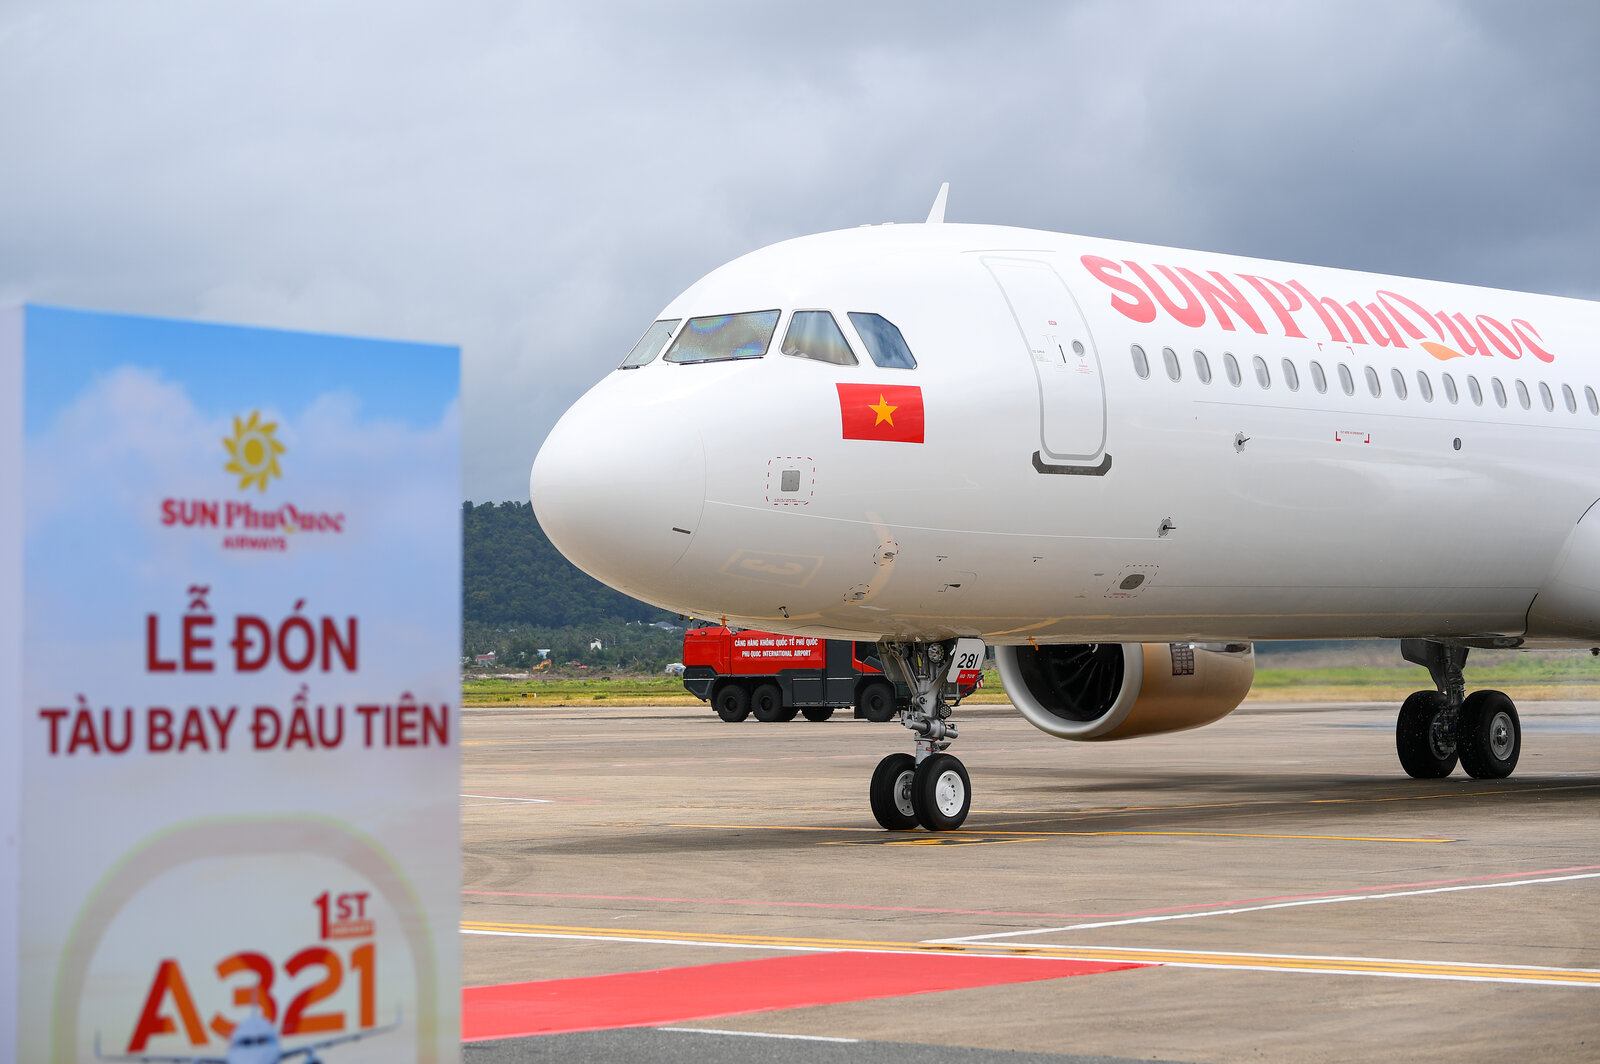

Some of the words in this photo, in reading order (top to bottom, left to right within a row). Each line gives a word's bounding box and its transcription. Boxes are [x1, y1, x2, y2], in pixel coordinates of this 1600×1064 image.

[1080, 254, 1268, 334] SUN
[161, 498, 219, 528] SUN
[223, 536, 287, 551] AIRWAYS
[145, 585, 216, 673] LỄ
[229, 598, 359, 673] ĐÓN
[751, 650, 762, 658] QUOC
[957, 653, 979, 669] 281
[39, 694, 134, 755] TÀU
[147, 706, 238, 753] BAY
[249, 683, 344, 751] ĐẦU
[356, 692, 449, 747] TIÊN
[313, 890, 371, 940] 1ST
[126, 941, 377, 1053] A321
